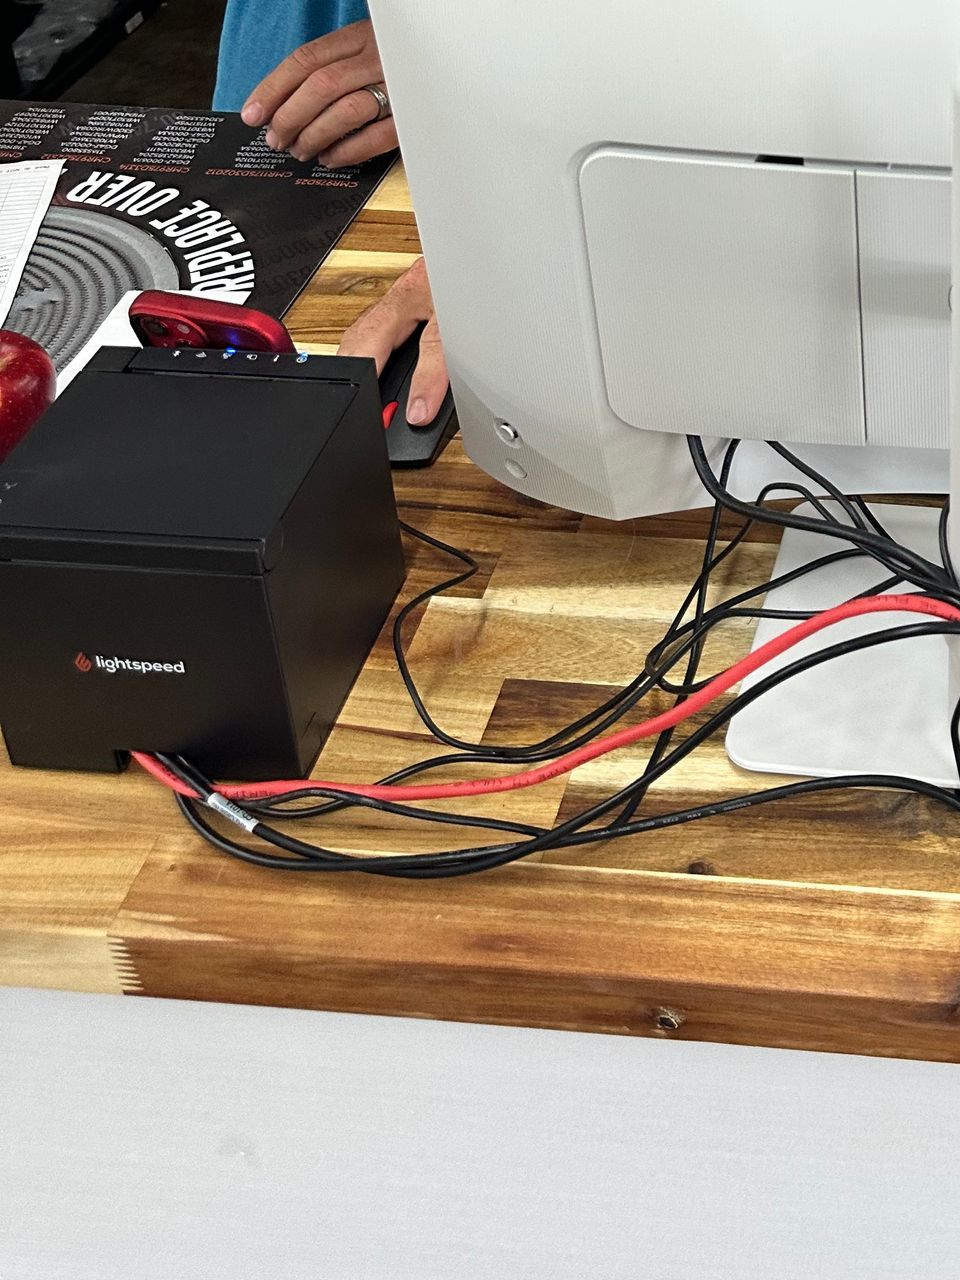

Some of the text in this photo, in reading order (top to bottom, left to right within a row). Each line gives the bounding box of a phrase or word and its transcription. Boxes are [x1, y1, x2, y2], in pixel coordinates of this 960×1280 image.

[66, 171, 180, 217] OVER
[149, 199, 255, 292] REPLACE
[96, 656, 186, 674] lightspeed
